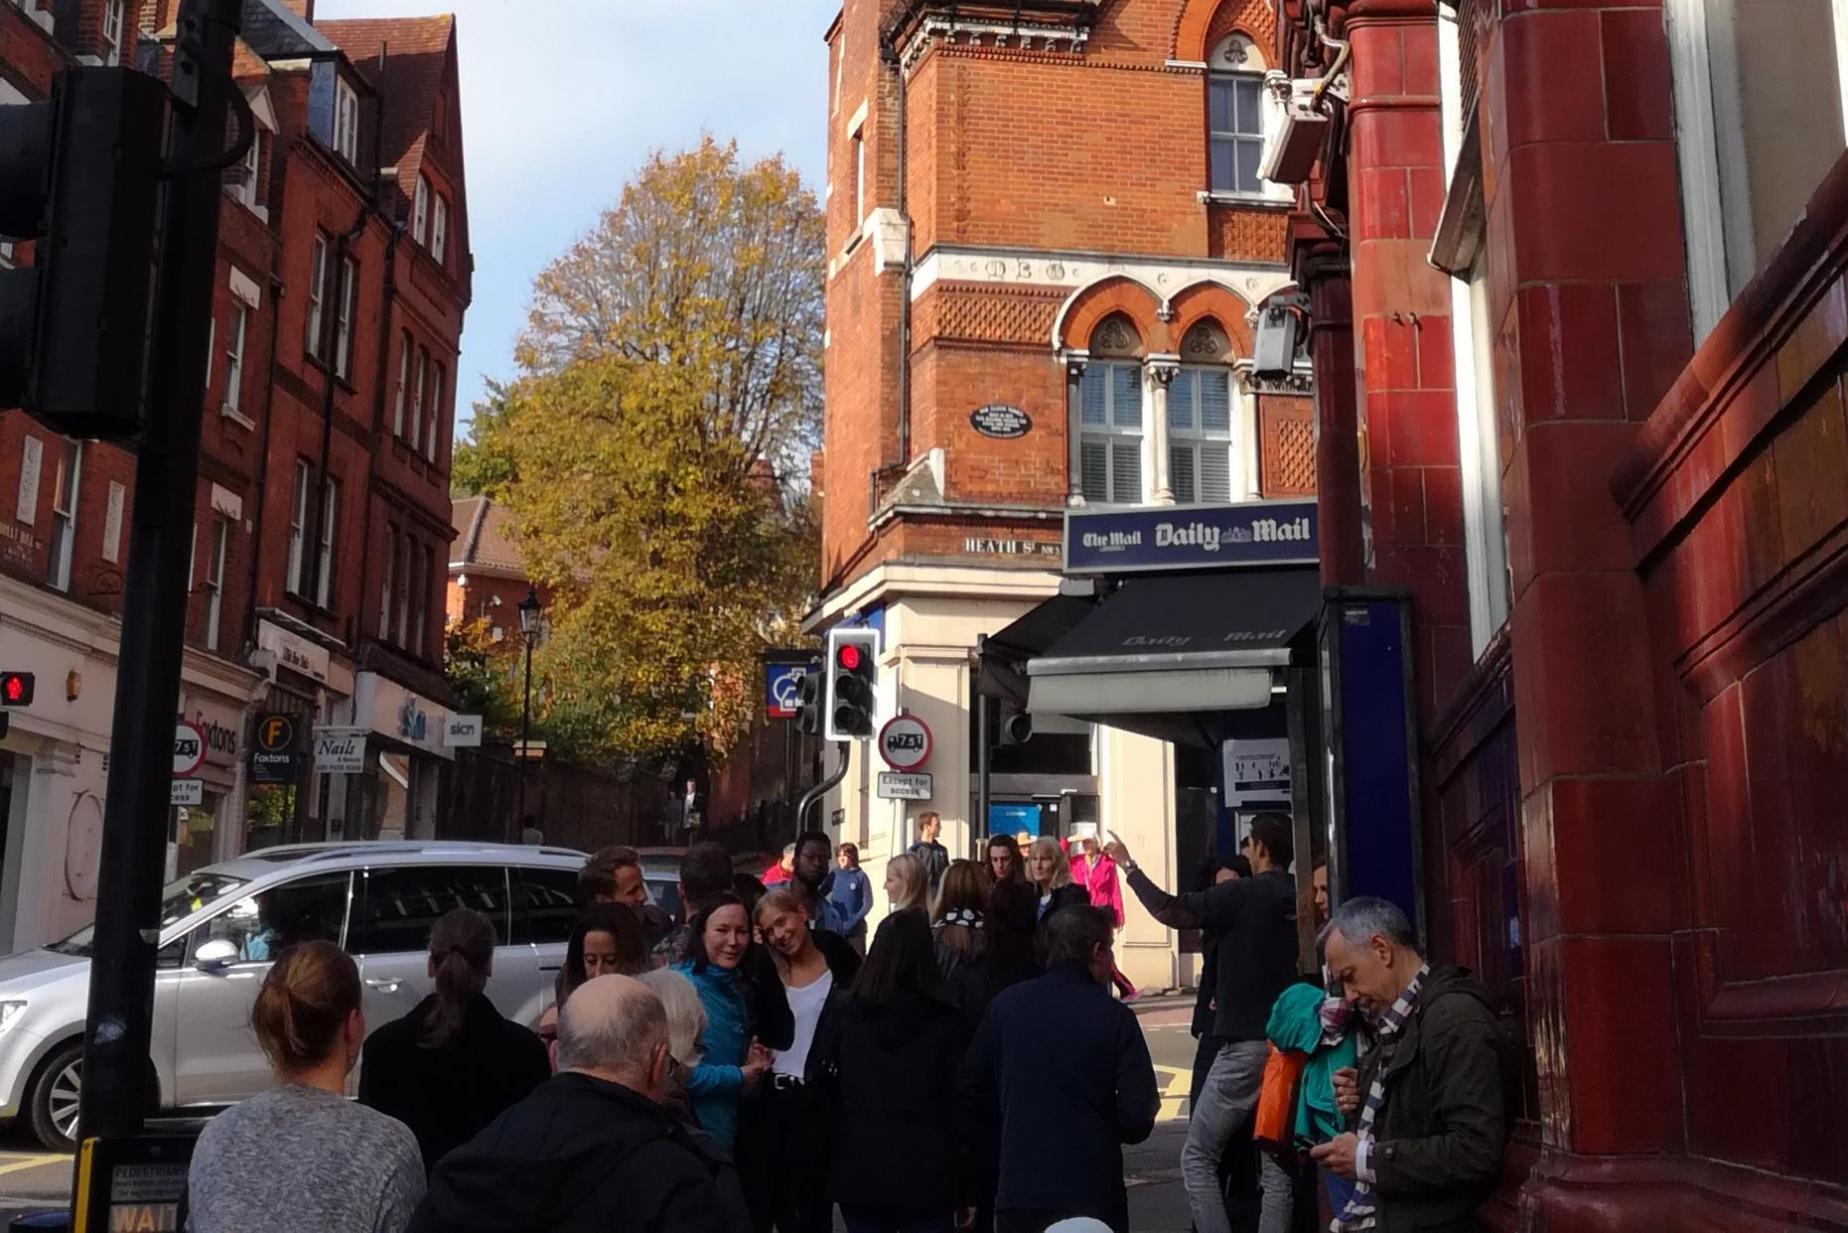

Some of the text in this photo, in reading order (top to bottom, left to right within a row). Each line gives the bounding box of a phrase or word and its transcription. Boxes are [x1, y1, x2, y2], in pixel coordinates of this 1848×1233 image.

[1083, 531, 1142, 547] The Mail
[1155, 517, 1310, 551] Daily Mail
[965, 538, 1016, 553] HEATH
[267, 720, 283, 746] F
[317, 737, 356, 756] Nails
[254, 752, 291, 764] Foxtons
[882, 775, 928, 786] Except for
